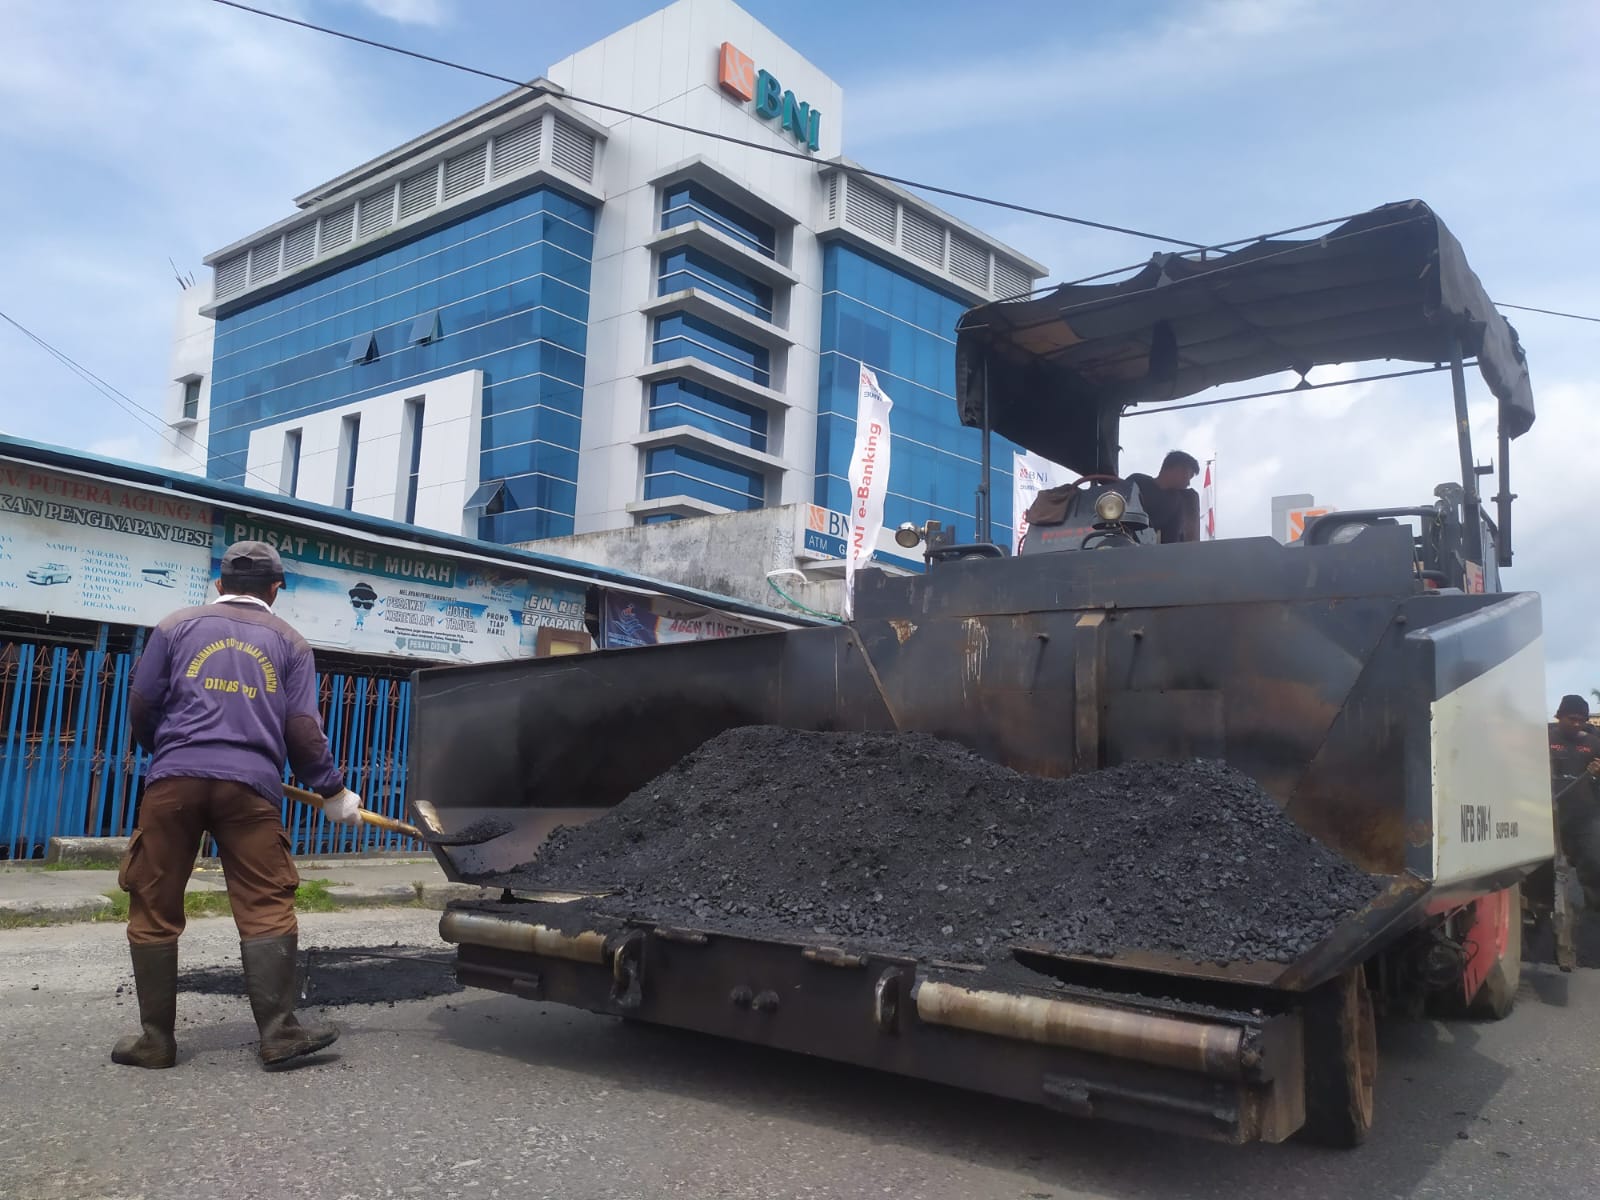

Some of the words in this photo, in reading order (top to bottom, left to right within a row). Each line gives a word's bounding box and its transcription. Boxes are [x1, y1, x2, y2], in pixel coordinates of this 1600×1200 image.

[756, 69, 821, 152] BNI
[857, 423, 882, 518] e-Banking
[1029, 471, 1048, 483] BNI
[29, 473, 112, 506] PUTERA
[119, 492, 191, 520] AGUNG
[45, 502, 169, 540] PENGINAPAN
[809, 535, 828, 550] ATM
[233, 523, 308, 556] PUSAT
[316, 541, 375, 570] TIKET
[385, 555, 450, 583] MURAH
[386, 596, 427, 612] PESAWAT
[445, 605, 473, 619] HOTEL
[384, 610, 419, 626] KERETA
[419, 614, 436, 627] API
[486, 612, 509, 622] PROMO
[490, 620, 505, 628] TIAP
[446, 618, 478, 633] TRAVEL
[670, 619, 700, 634] AGEN
[204, 677, 240, 693] DINAS
[241, 684, 258, 699] PU
[1495, 822, 1510, 839] SUPER
